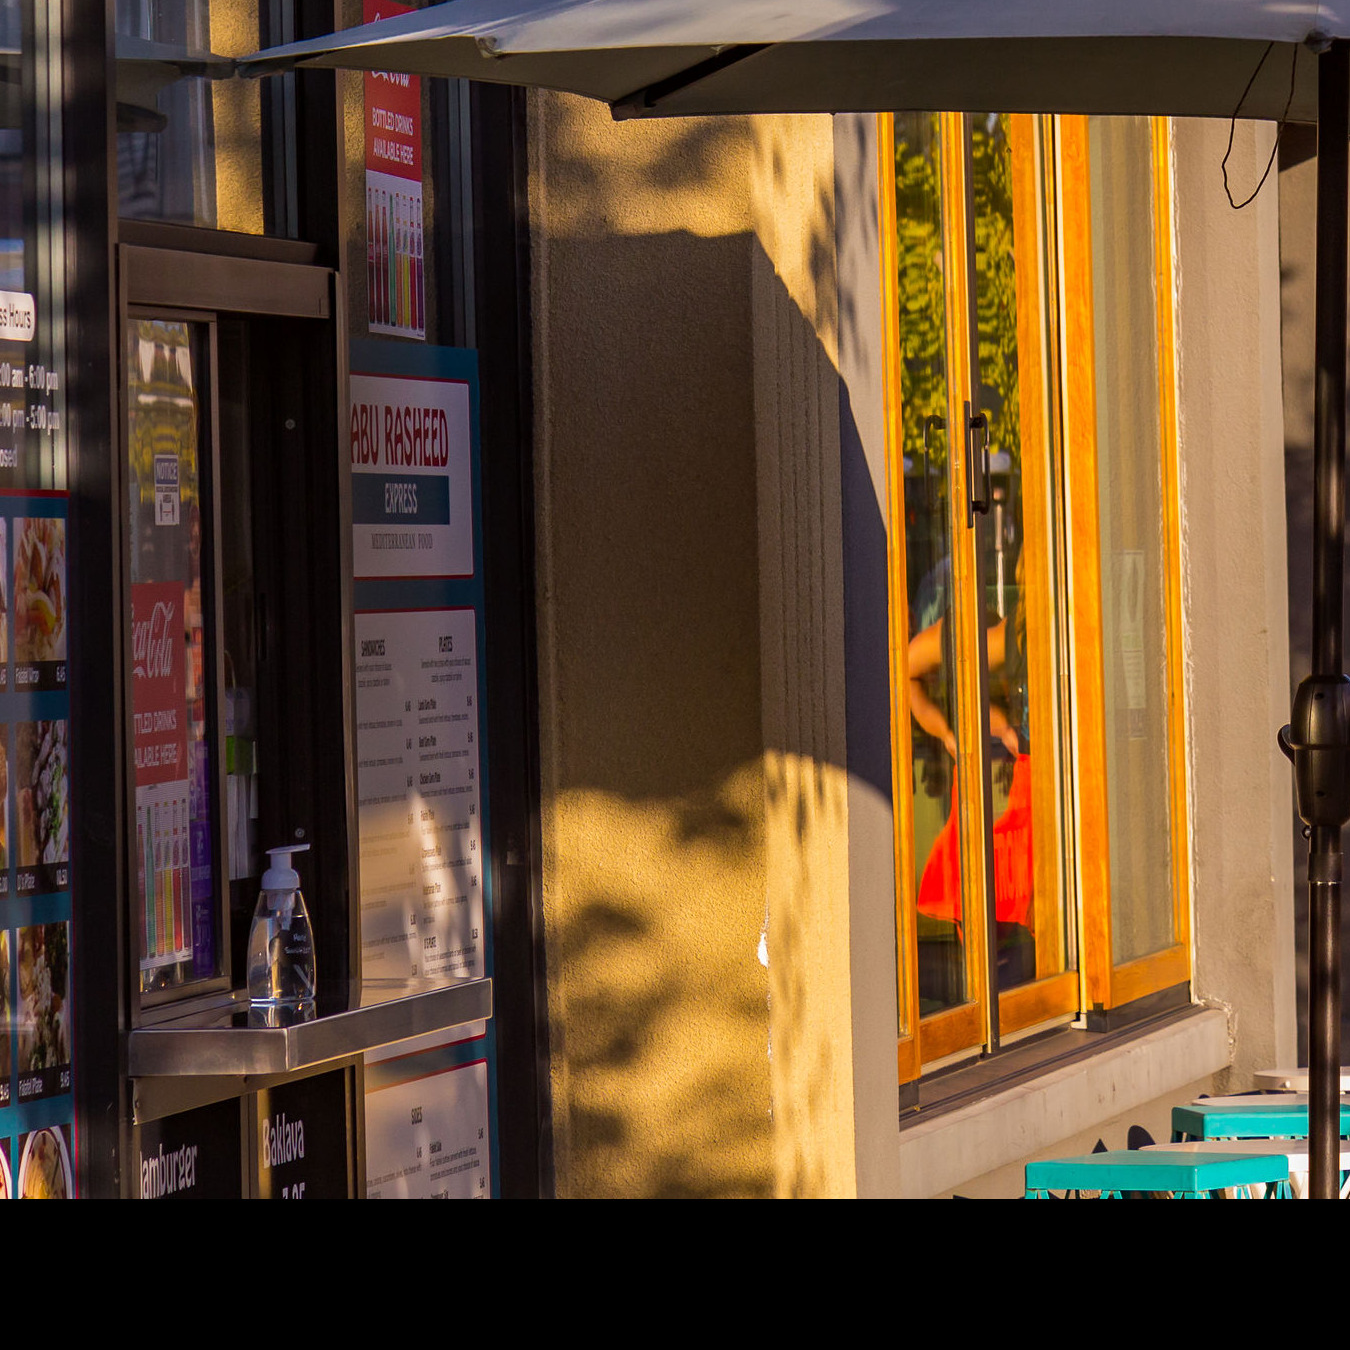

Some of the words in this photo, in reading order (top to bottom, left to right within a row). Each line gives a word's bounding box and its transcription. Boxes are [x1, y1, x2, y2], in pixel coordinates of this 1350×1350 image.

[372, 107, 394, 131] BOTTLED
[395, 113, 414, 136] DRINKS
[373, 137, 400, 162] AVAILABLE
[400, 144, 414, 166] HERE
[9, 303, 32, 330] Hours
[12, 369, 24, 388] am
[29, 364, 45, 389] 6:00
[46, 371, 59, 396] pm
[30, 404, 46, 430] 5:00
[47, 411, 60, 435] pm
[351, 403, 379, 466] ABU
[384, 406, 449, 467] RASHEED
[384, 482, 418, 514] EXPRESS
[371, 533, 416, 550] MEDITERRANEAN
[418, 533, 433, 550] FOOD
[133, 712, 152, 735] TTLED
[153, 709, 177, 732] DRINKS
[160, 743, 177, 764] HERE
[262, 1113, 304, 1169] Baklava
[140, 1143, 198, 1199] amburger
